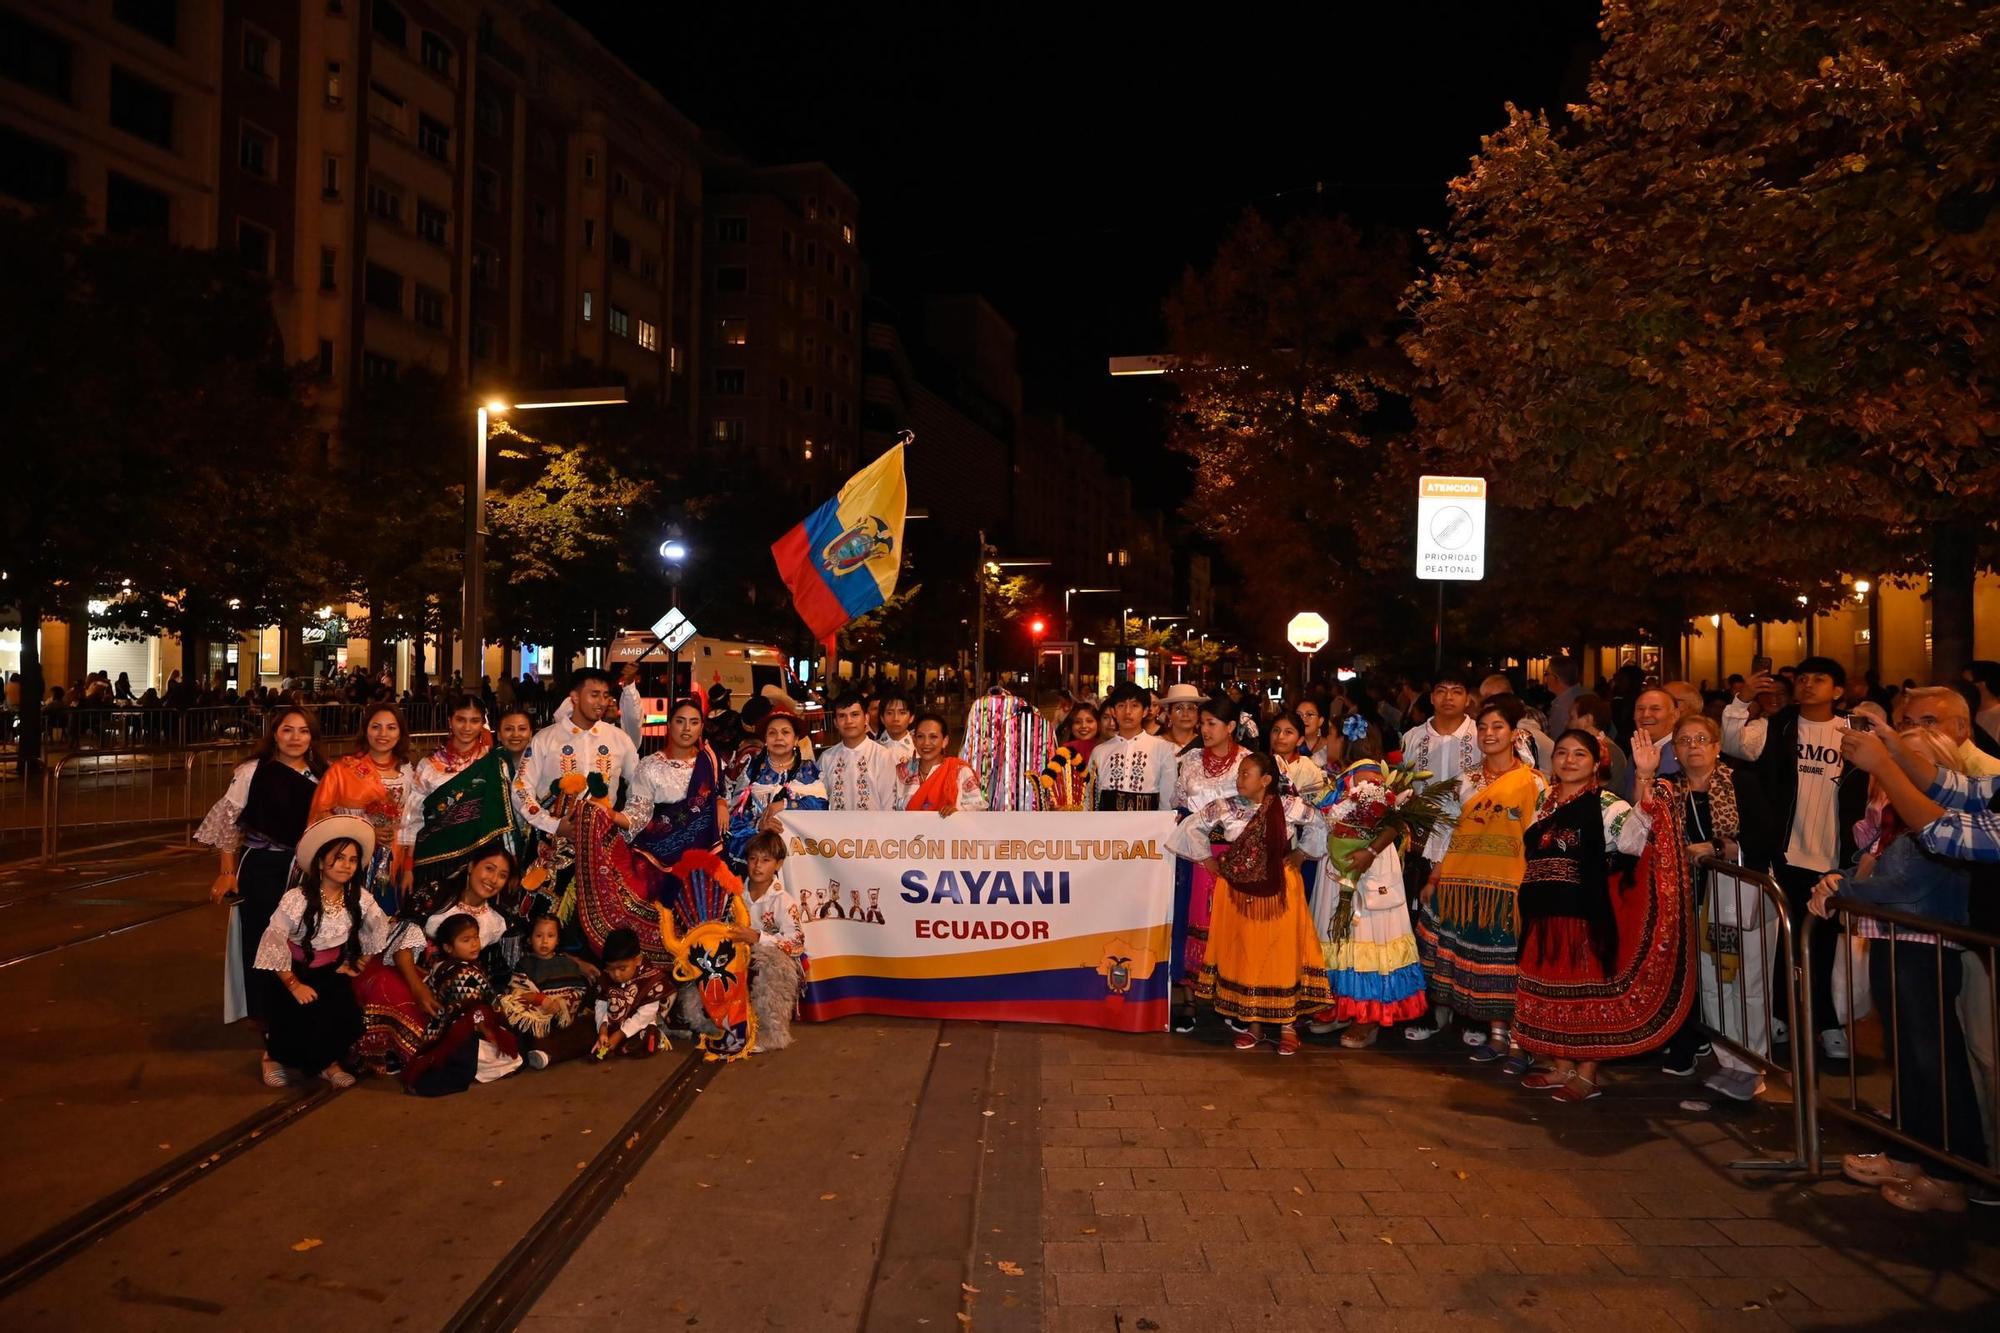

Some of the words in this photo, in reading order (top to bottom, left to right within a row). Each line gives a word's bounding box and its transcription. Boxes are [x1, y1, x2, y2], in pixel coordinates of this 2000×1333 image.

[1425, 553, 1477, 562] PRIORIDAD
[1425, 565, 1475, 573] PEATONAL
[1799, 764, 1824, 776] SQUARE
[789, 834, 946, 859] ASOCIACIÓN
[951, 839, 1163, 860] INTERCULTURAL
[900, 870, 1070, 904] SAYANI
[915, 919, 1049, 940] ECUADOR
